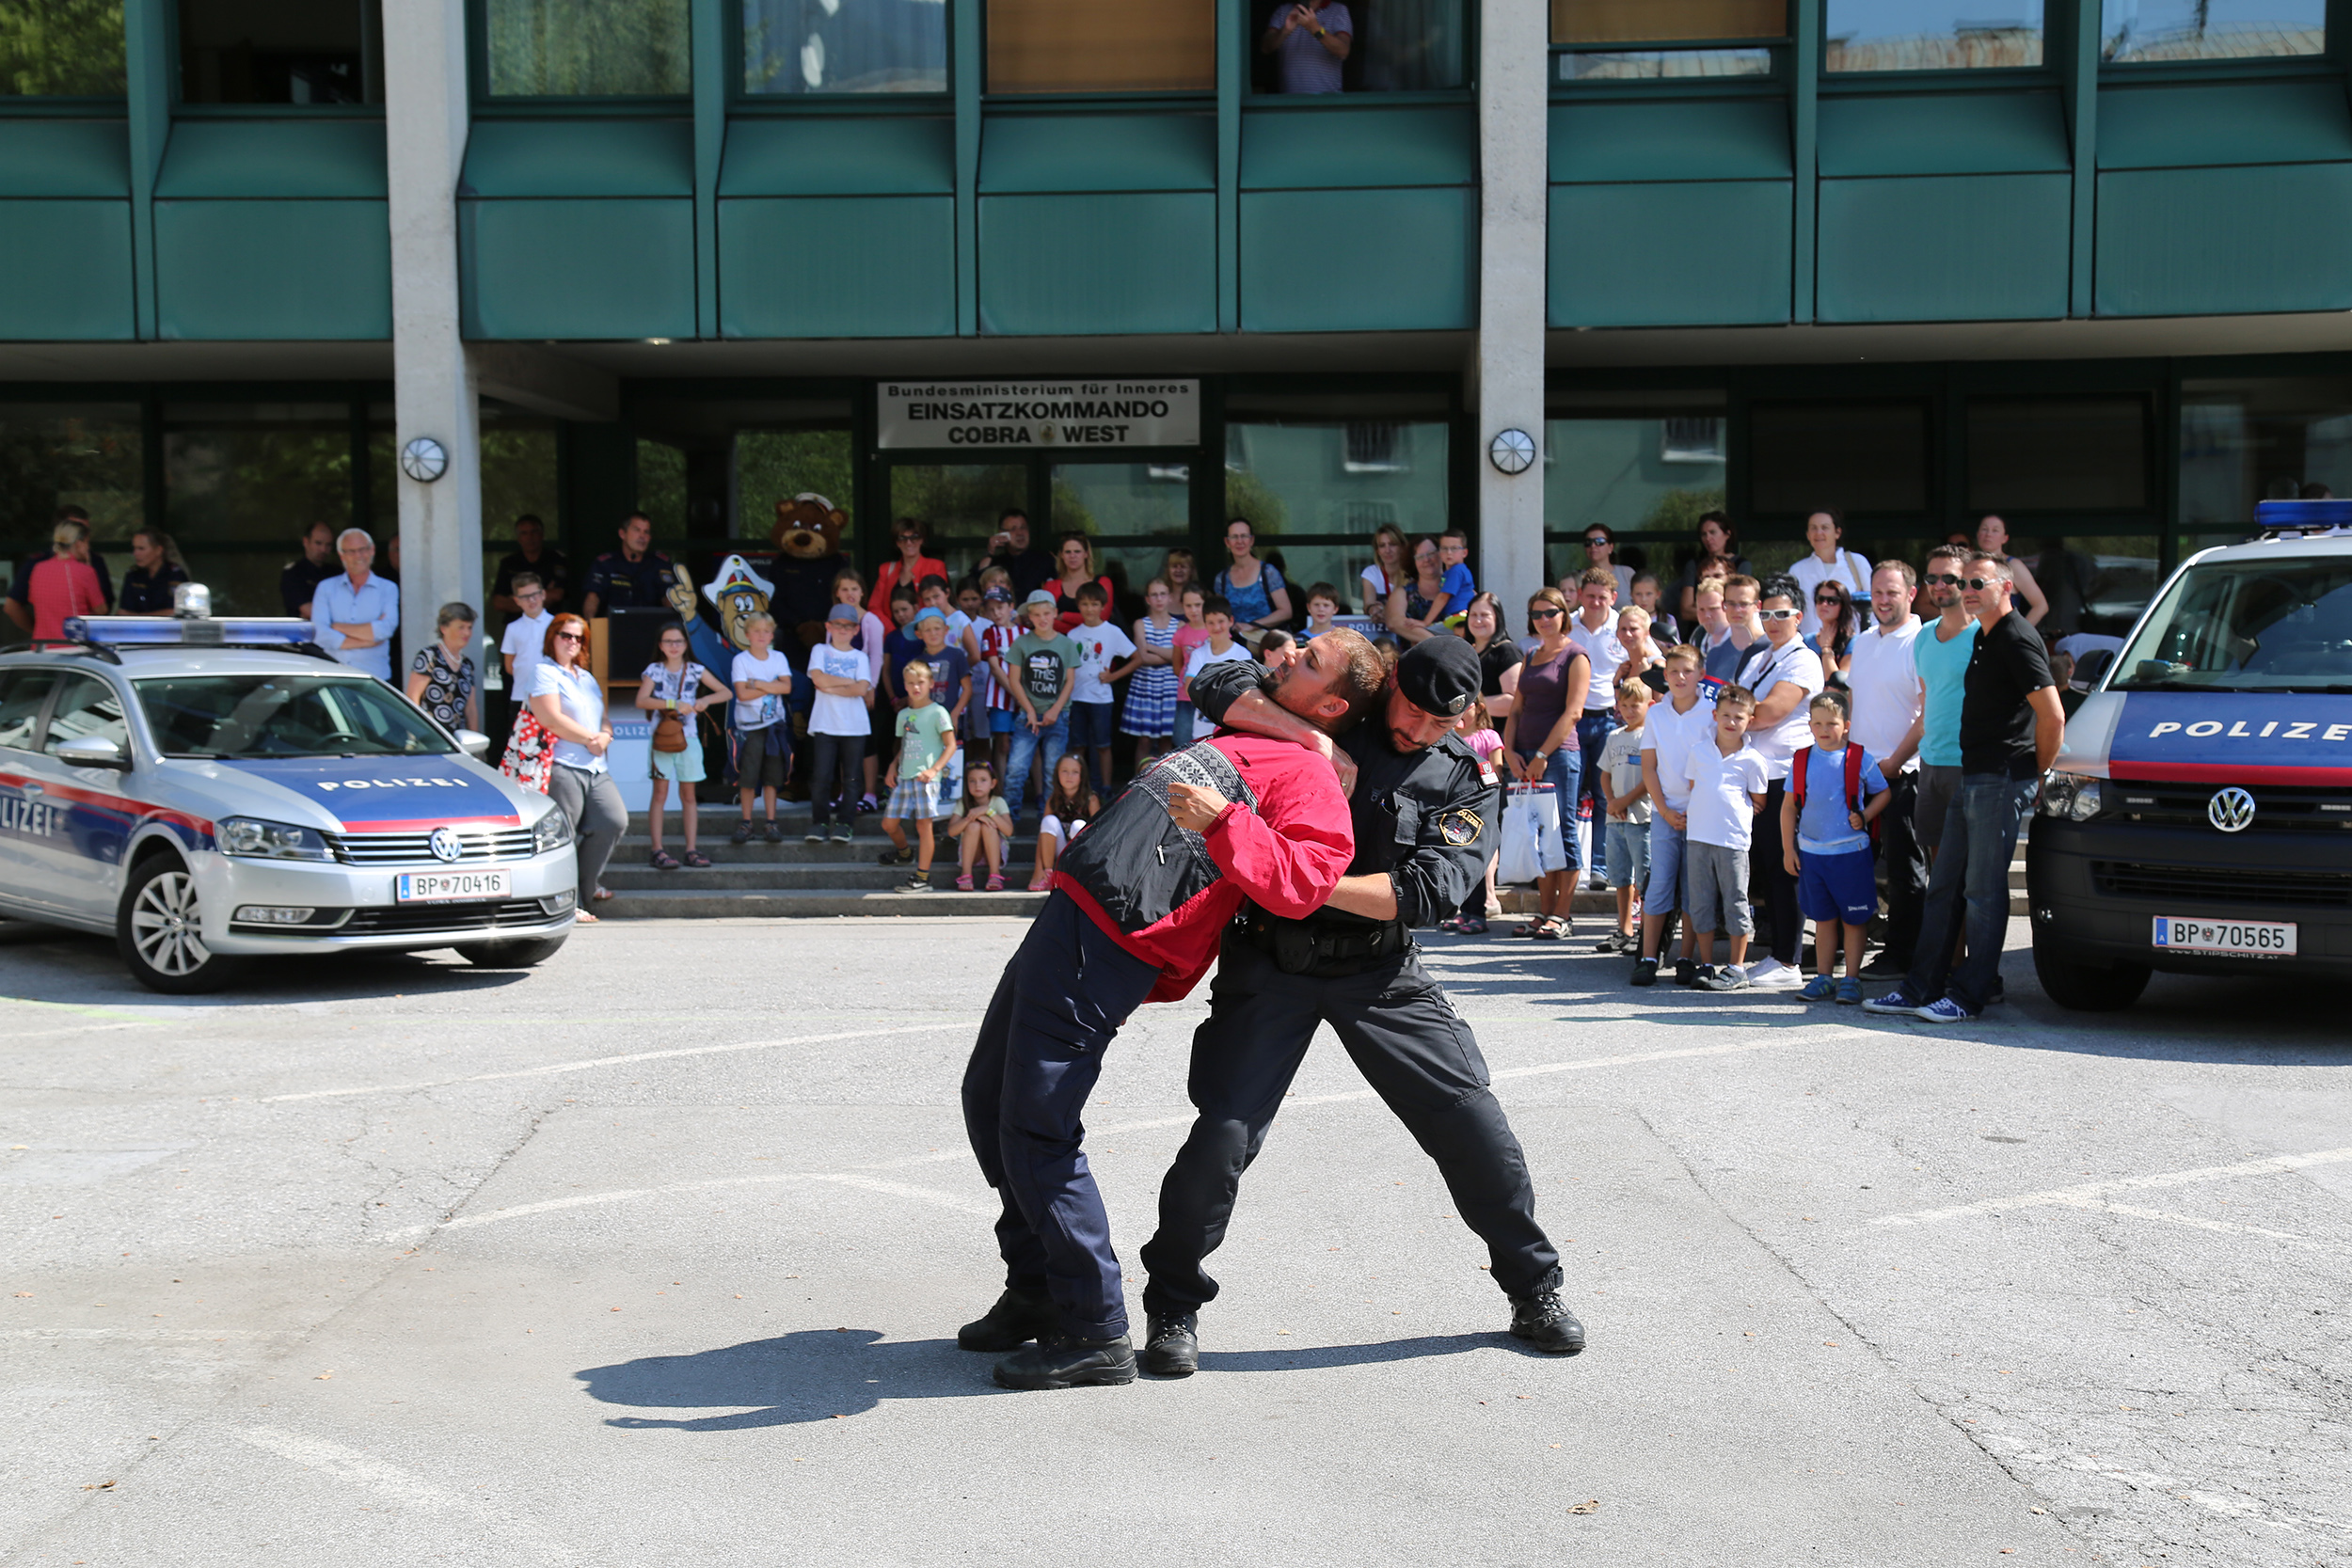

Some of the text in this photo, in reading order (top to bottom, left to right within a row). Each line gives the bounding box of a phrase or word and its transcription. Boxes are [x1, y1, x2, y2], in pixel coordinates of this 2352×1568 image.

[888, 383, 1189, 397] Bundesministerium für Inneres
[908, 400, 1168, 420] EINSATZKOMMANDO
[948, 425, 1129, 444] COBRA WEST
[1033, 669, 1056, 681] THIS
[1031, 681, 1057, 694] TOWN
[613, 726, 650, 736] OLIZ
[2149, 721, 2352, 741] POLIZE
[317, 778, 469, 792] POLIZEI
[0, 797, 53, 837] LIZEI
[417, 878, 437, 895] BP
[452, 875, 501, 894] 70416
[2174, 923, 2199, 943] BP
[2217, 926, 2284, 948] 70565
